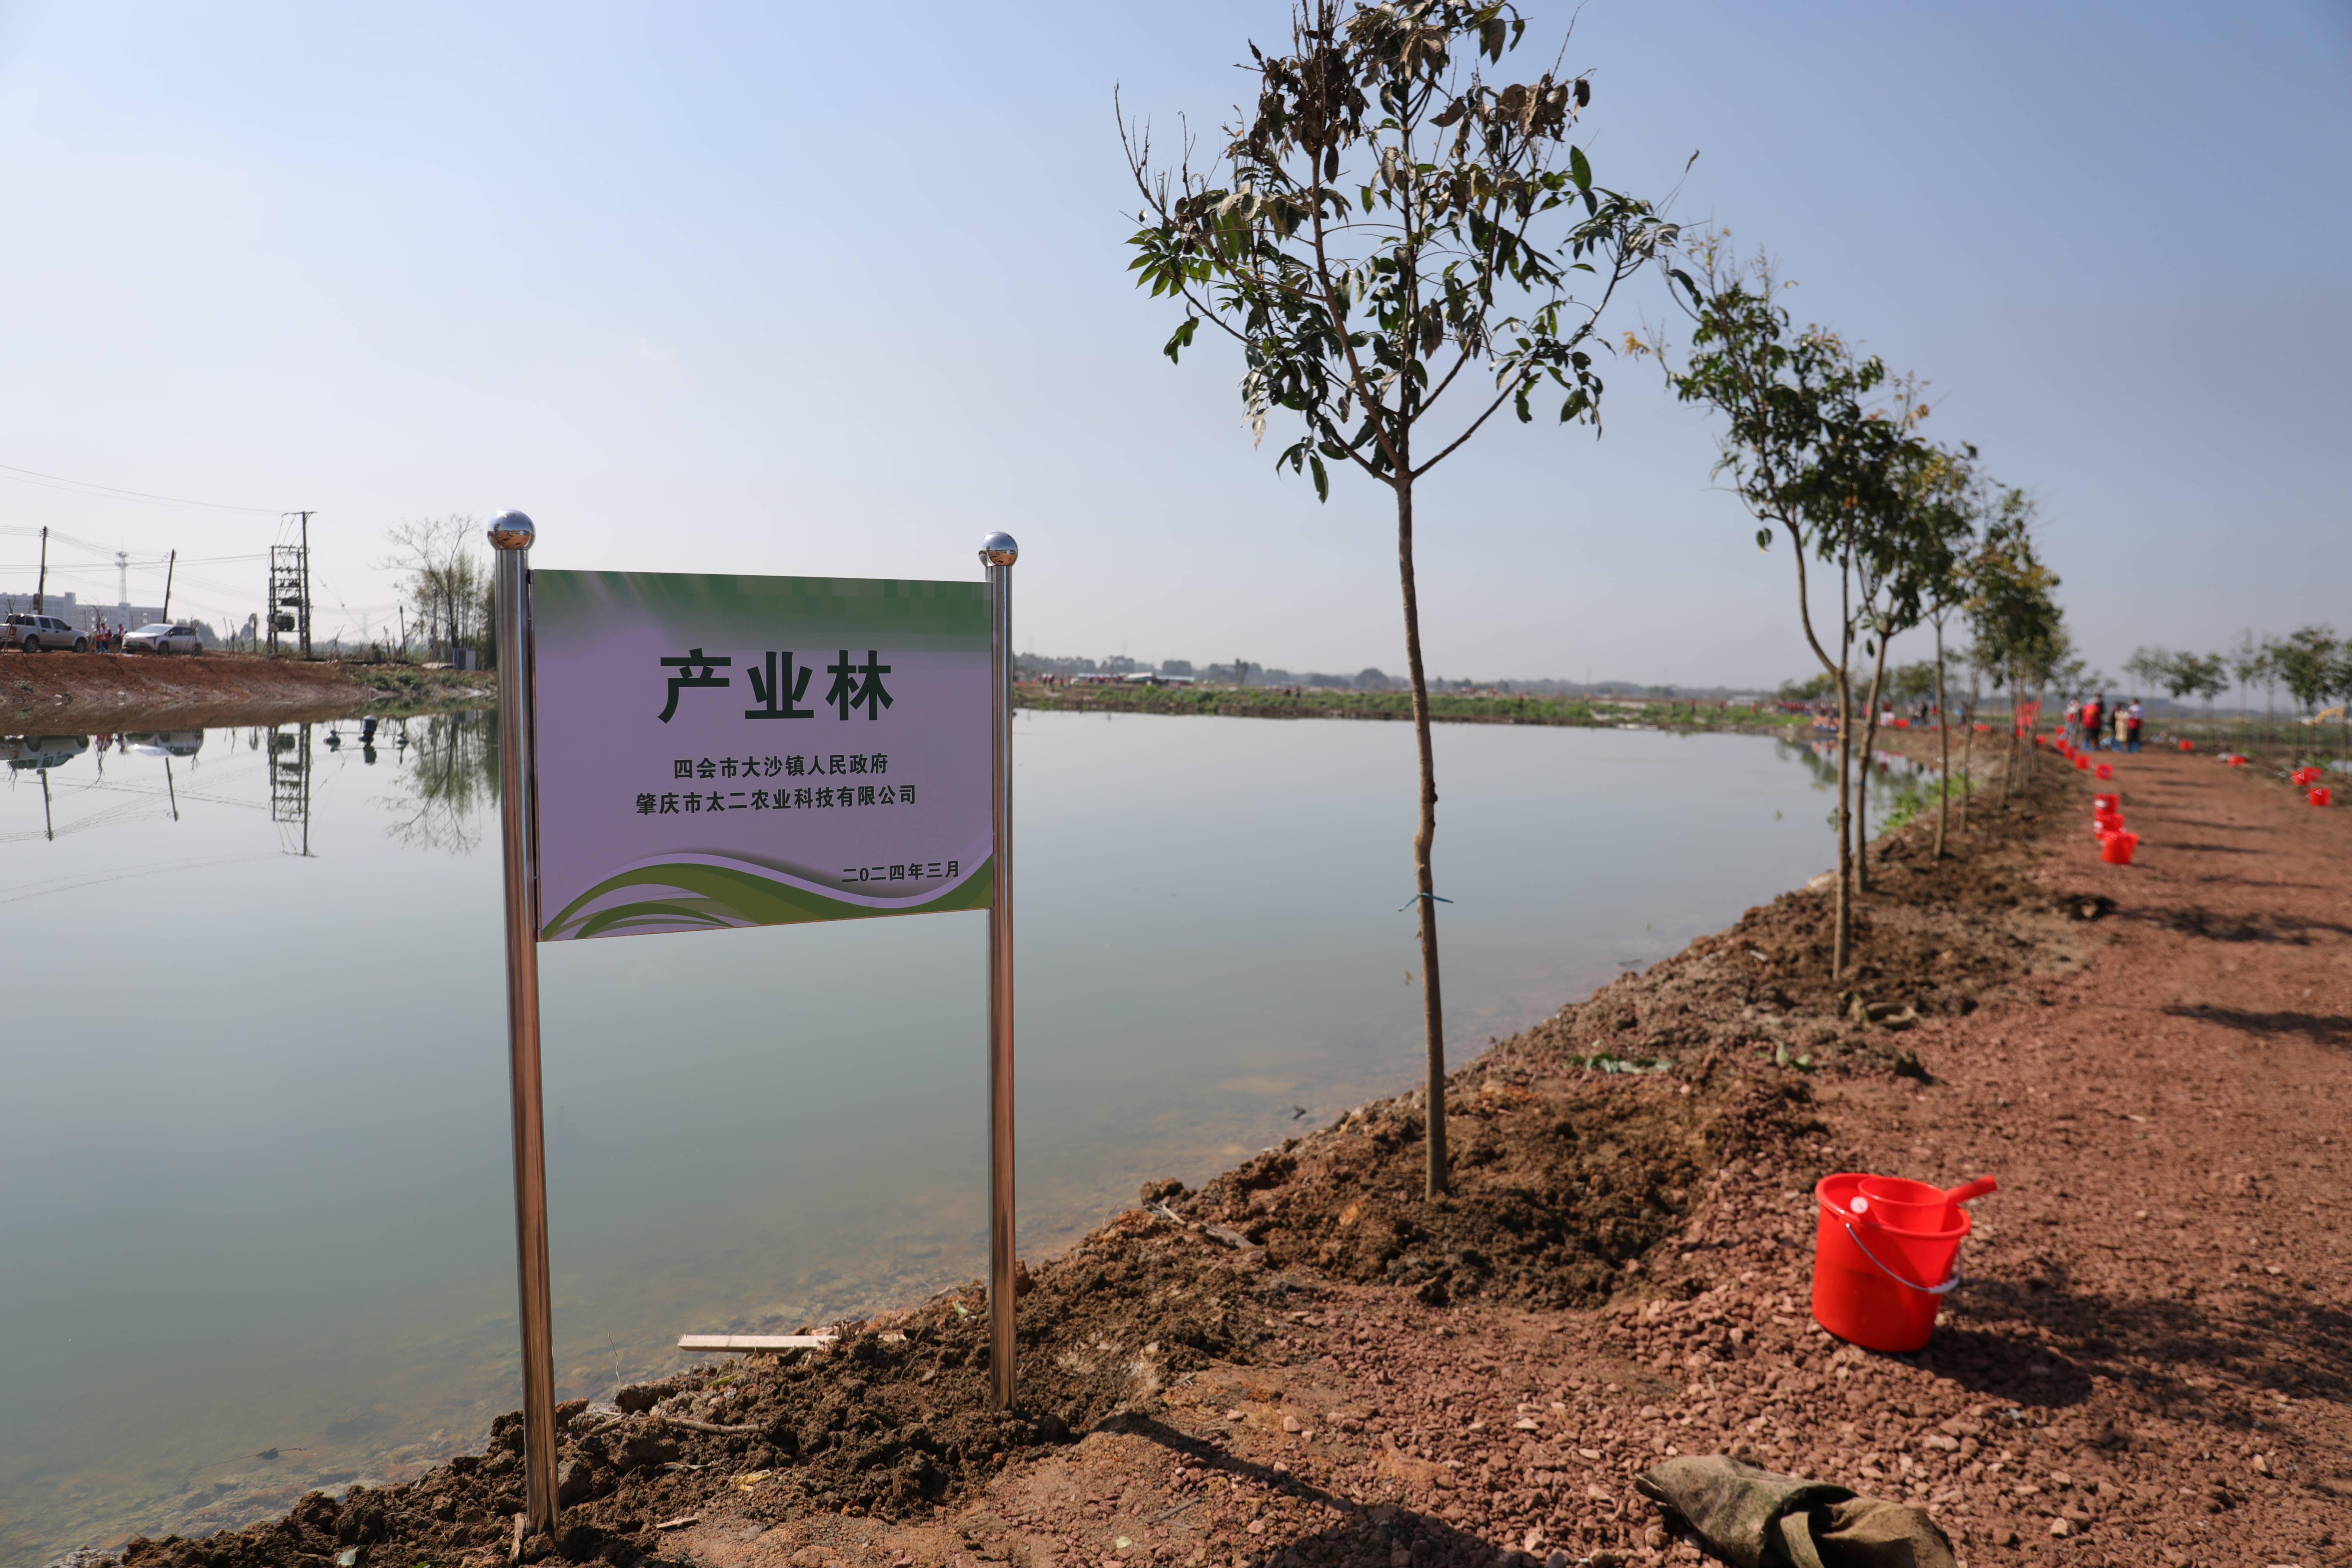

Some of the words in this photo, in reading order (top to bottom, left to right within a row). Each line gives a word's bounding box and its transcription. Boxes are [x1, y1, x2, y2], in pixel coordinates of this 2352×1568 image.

[658, 648, 894, 724] 产业林
[674, 753, 888, 779] 四会市大沙镇人民政府
[636, 785, 915, 816] 肇庆市太二农业科技有限公司
